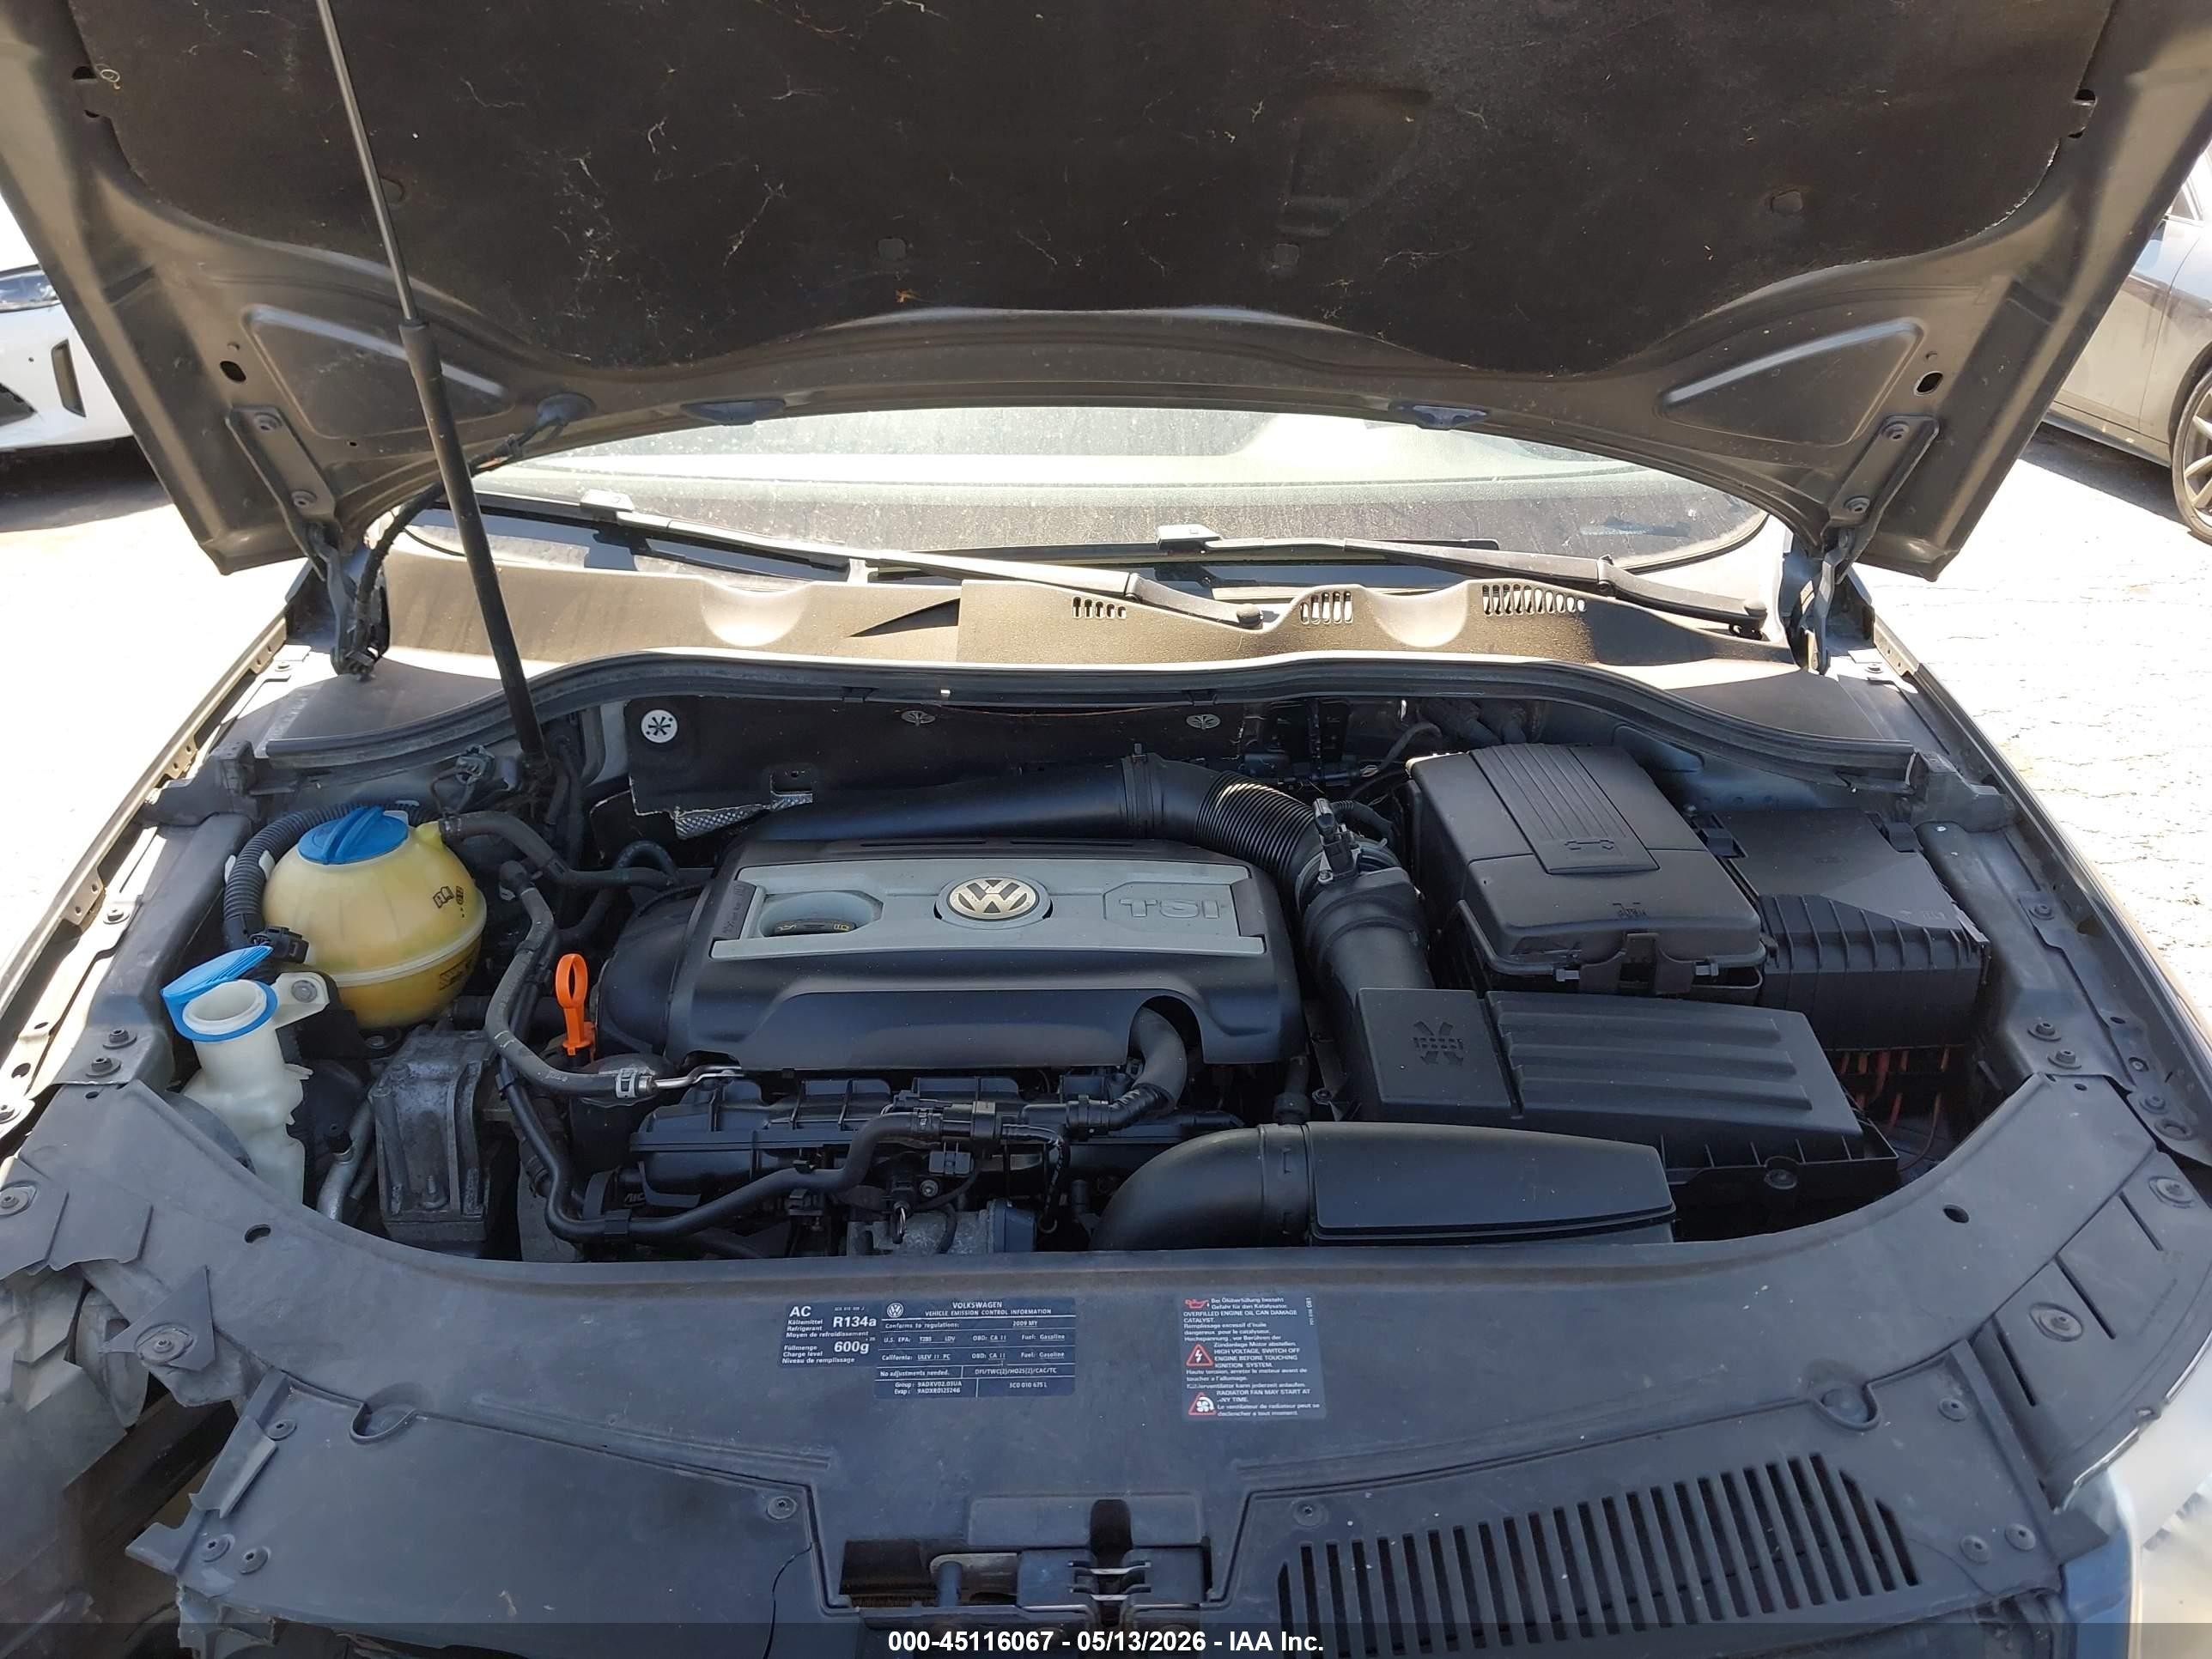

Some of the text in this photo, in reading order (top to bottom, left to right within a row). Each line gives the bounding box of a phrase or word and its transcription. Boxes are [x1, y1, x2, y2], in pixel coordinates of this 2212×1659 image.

[1119, 899, 1220, 919] TSI
[789, 1305, 811, 1317] AC
[833, 1316, 877, 1328] R134a
[834, 1340, 870, 1354] 600g
